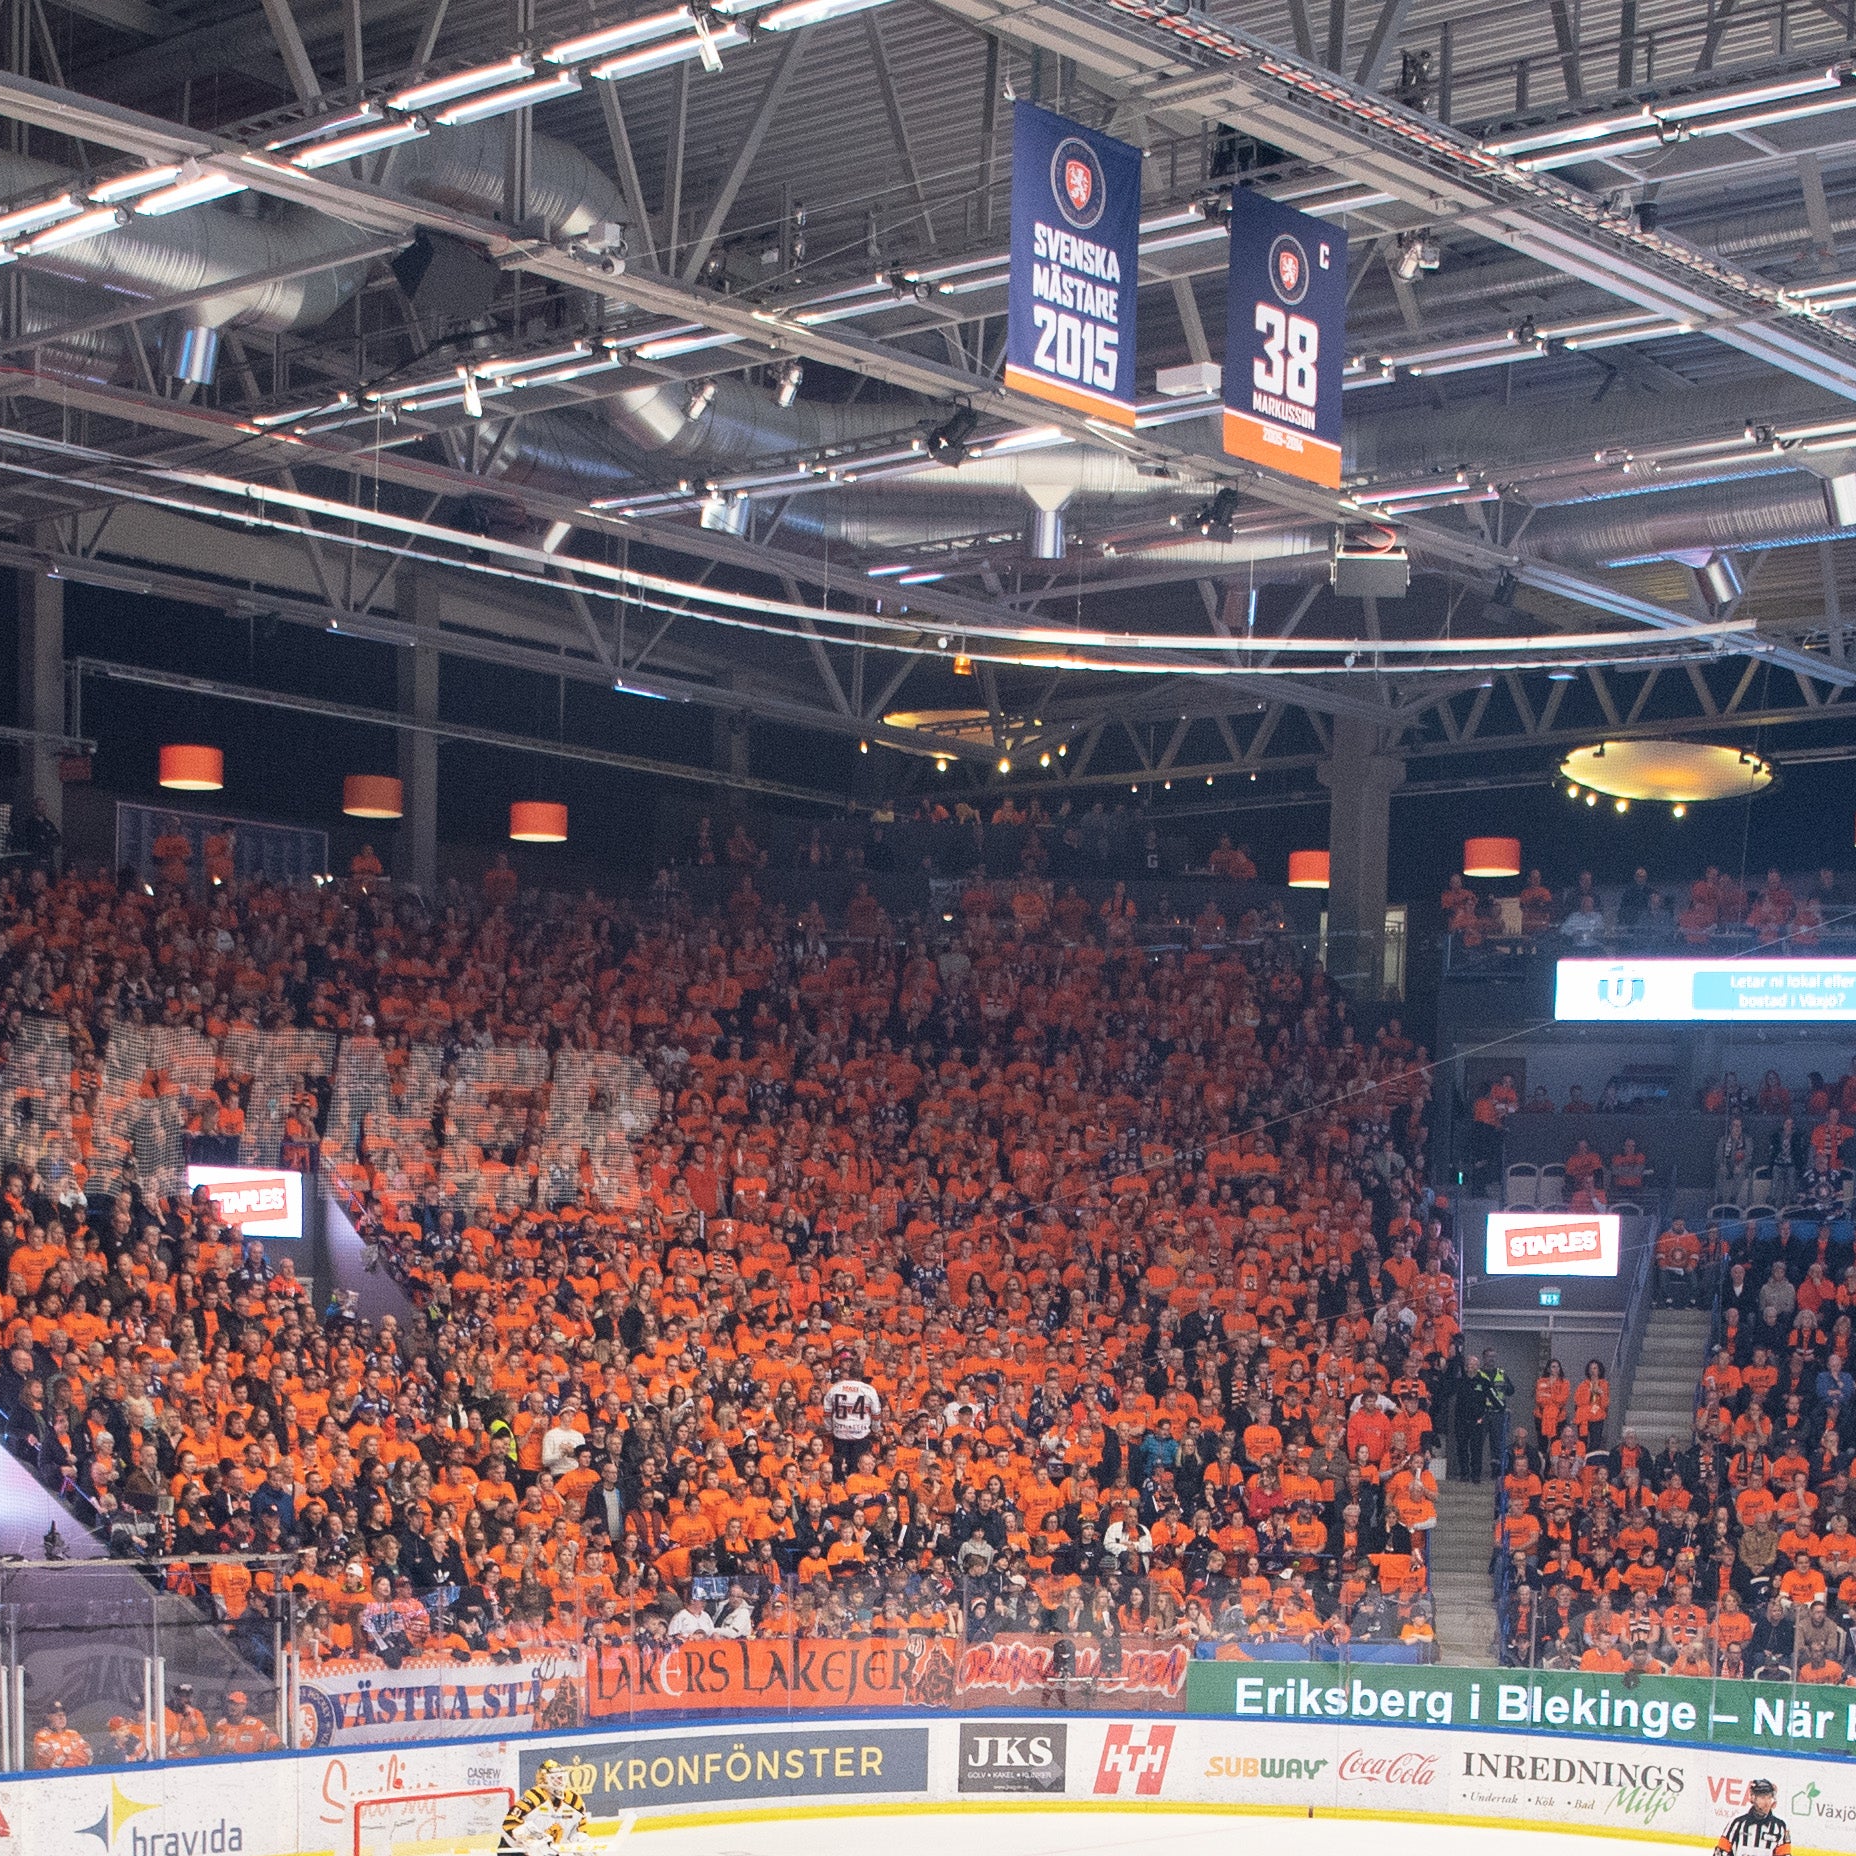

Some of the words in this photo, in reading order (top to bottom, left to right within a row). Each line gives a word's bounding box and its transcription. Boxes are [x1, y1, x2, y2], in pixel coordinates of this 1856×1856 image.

[1033, 222, 1121, 284] SVENSKA
[1033, 263, 1119, 324] MÄSTARE
[1033, 307, 1119, 392] 2015
[1253, 302, 1319, 407] 38
[1253, 391, 1316, 431] MARKUSSON
[210, 1185, 288, 1218] STAPLES
[1509, 1229, 1599, 1260] STAPLES
[834, 1393, 866, 1420] 64
[594, 1640, 730, 1701] LAKERS
[327, 1679, 470, 1730] VÄSTRA
[1236, 1677, 1454, 1725] Eriksberg
[1470, 1684, 1480, 1721] i
[1498, 1684, 1696, 1740] Blekinge
[1753, 1697, 1834, 1740] När
[603, 1742, 884, 1793] KRONFÖNSTER
[967, 1736, 1054, 1767] JKS
[1104, 1744, 1166, 1773] HTH
[1204, 1756, 1329, 1780] SUBWAY
[1339, 1748, 1440, 1786] Coca-Cola
[467, 1767, 502, 1779] CASHEW
[1461, 1751, 1685, 1794] INREDNINGS
[1707, 1775, 1778, 1808] VEA
[1470, 1791, 1518, 1806] Undertak
[1534, 1795, 1555, 1808] Kök
[1574, 1798, 1595, 1811] Bad
[1604, 1783, 1679, 1826] Miljö
